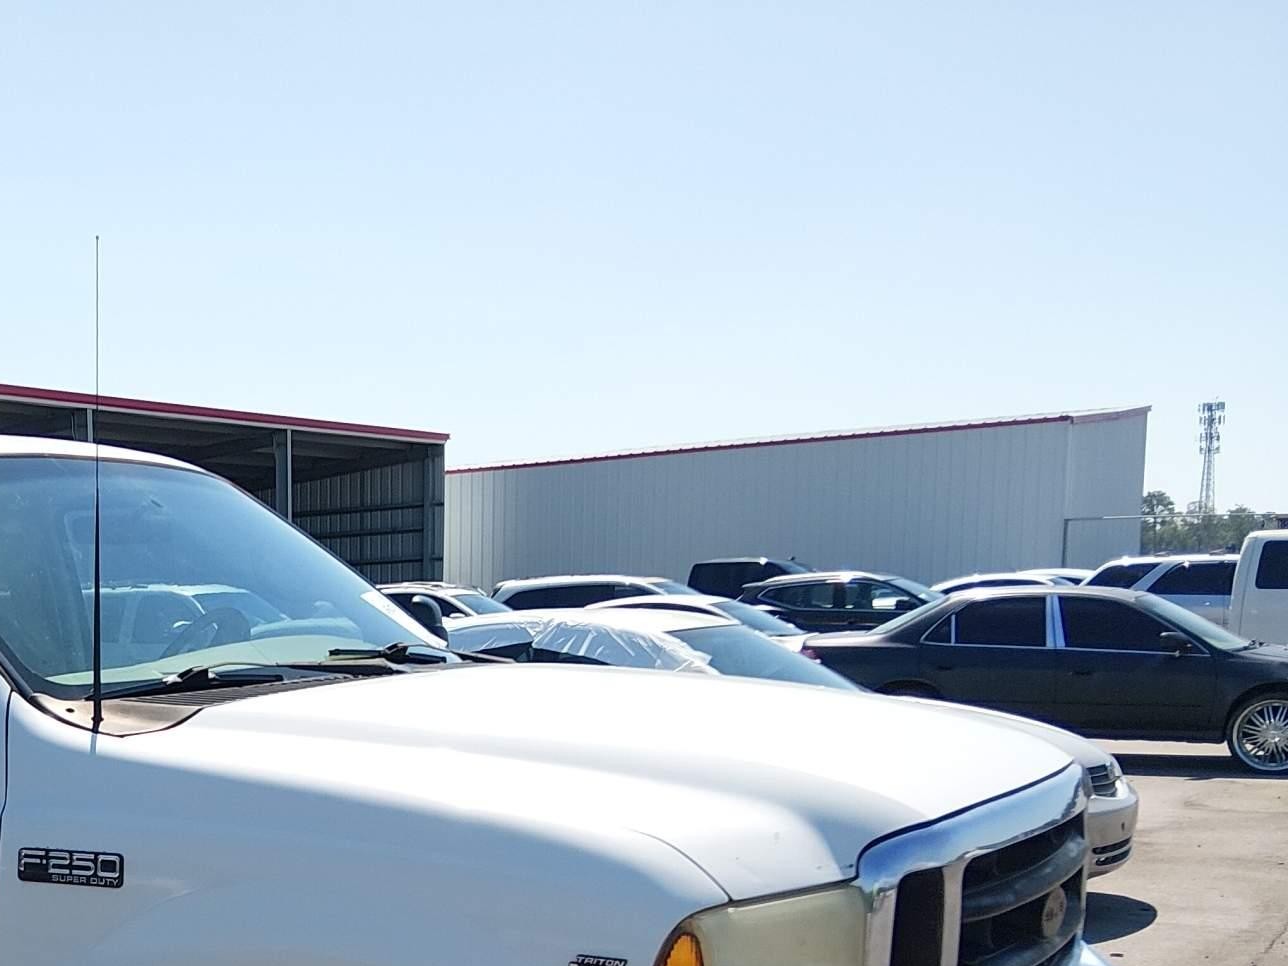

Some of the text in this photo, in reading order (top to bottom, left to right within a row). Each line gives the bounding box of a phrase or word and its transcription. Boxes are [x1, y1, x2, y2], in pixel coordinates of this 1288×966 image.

[51, 875, 119, 886] SUPER DUTY
[576, 957, 625, 966] TRITON
